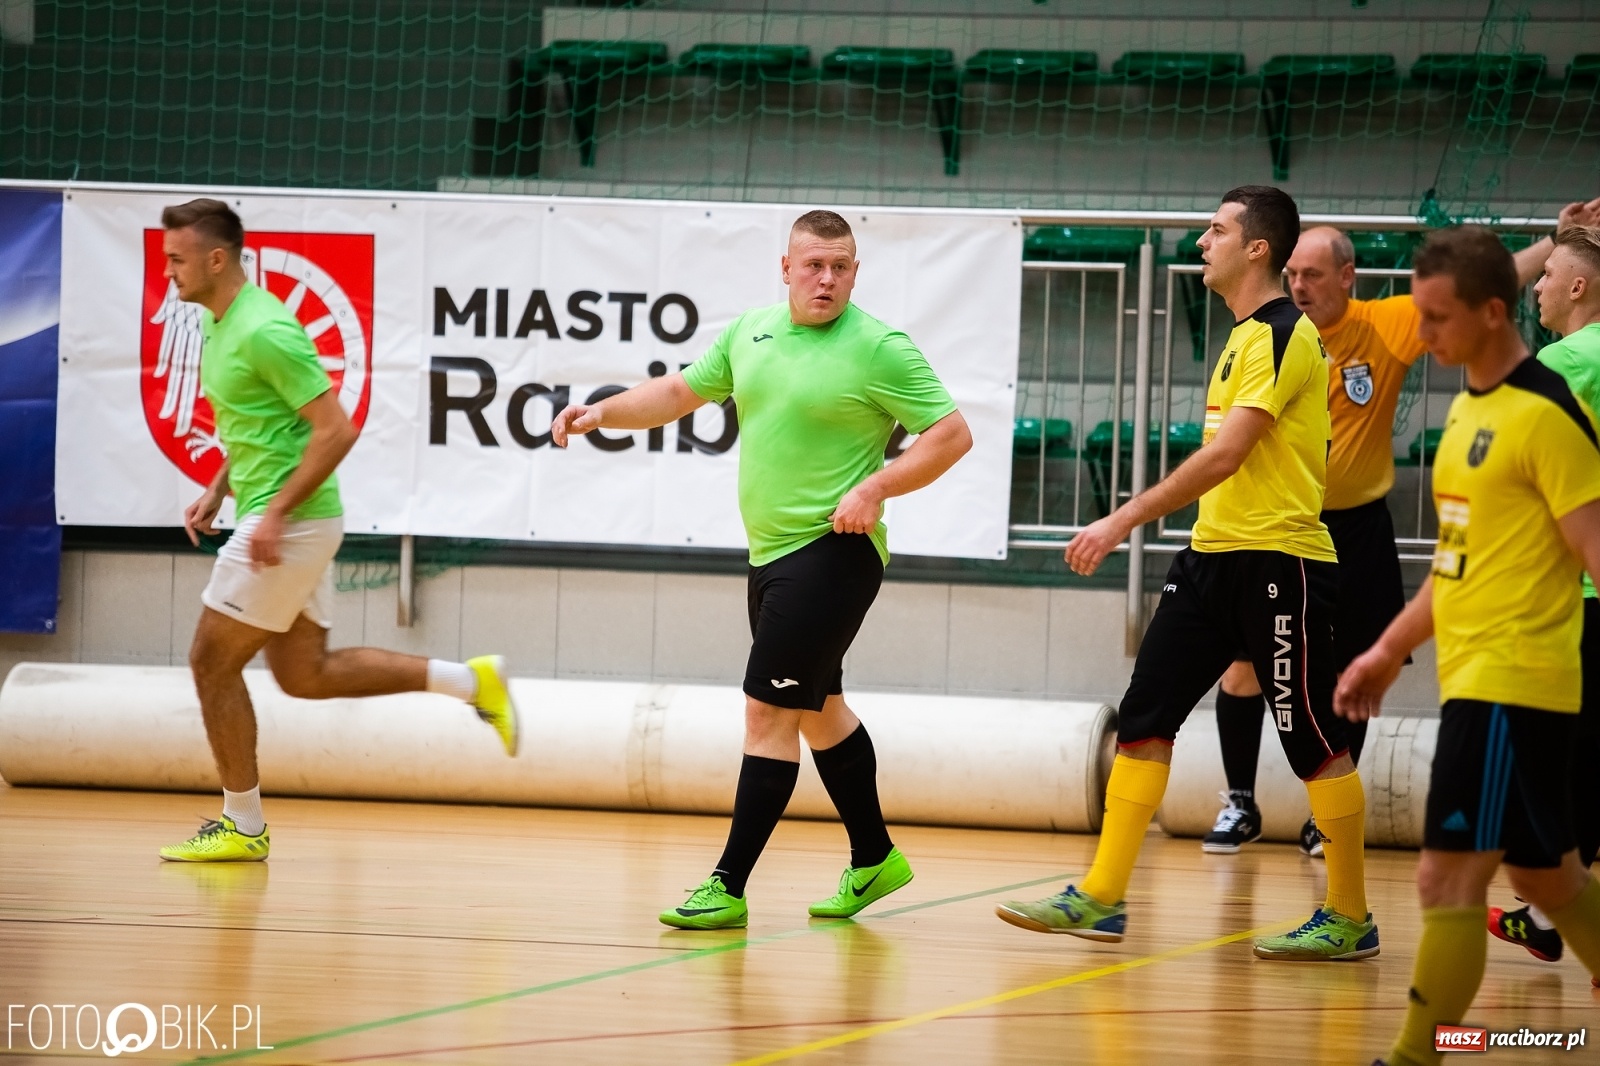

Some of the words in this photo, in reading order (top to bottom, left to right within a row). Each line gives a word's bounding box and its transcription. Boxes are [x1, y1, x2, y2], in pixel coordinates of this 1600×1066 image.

[433, 286, 699, 344] MIASTO
[1267, 583, 1278, 599] 9
[1273, 614, 1293, 732] GIVOVA
